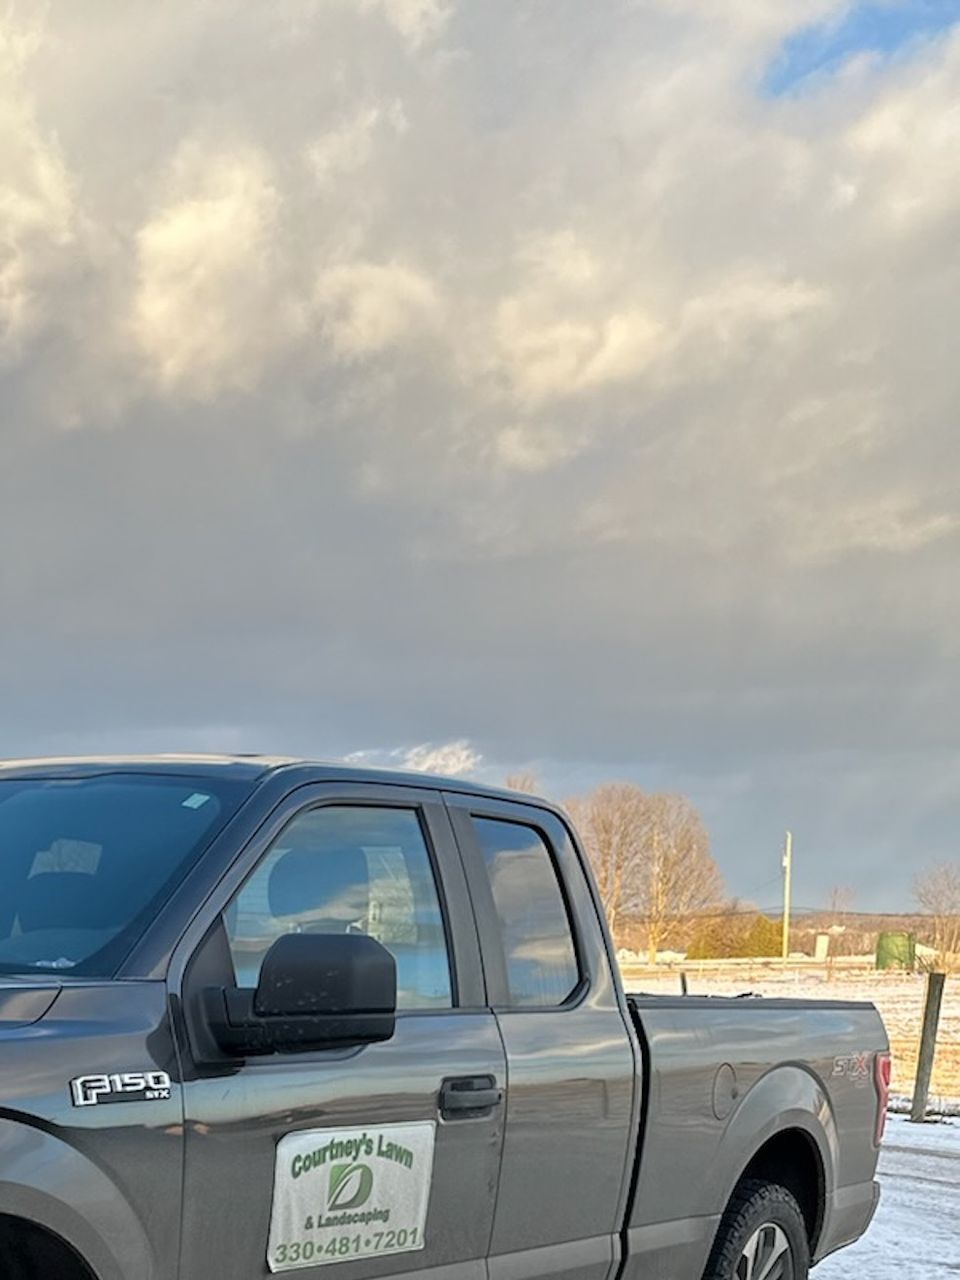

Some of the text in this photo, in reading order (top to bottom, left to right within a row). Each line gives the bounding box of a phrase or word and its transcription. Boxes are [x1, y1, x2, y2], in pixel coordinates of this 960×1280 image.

[291, 1133, 414, 1180] Courtney's Lawn
[304, 1208, 391, 1230] & Landscaping
